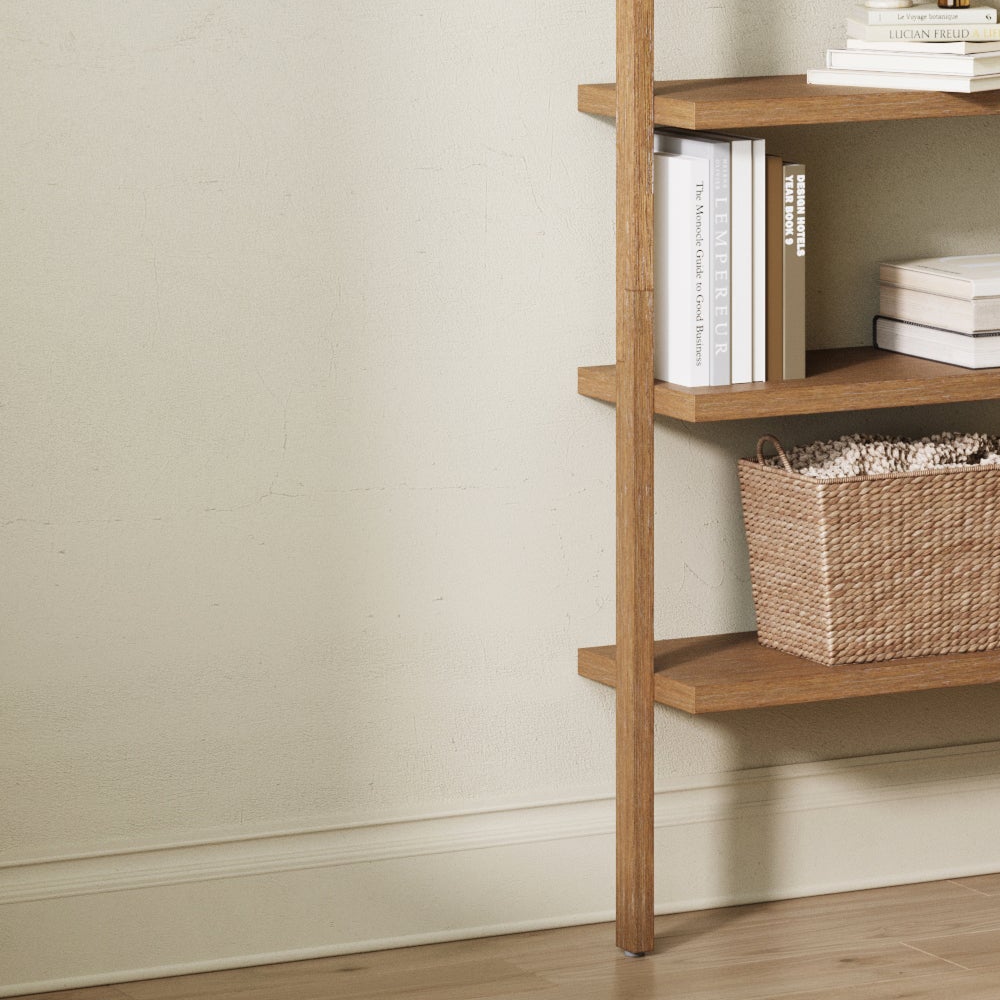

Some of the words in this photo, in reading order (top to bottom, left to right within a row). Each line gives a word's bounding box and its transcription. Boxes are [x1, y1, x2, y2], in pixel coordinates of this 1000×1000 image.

[906, 13, 927, 22] Voyage
[889, 29, 930, 39] LUCIAN
[934, 28, 970, 39] FREUD
[695, 181, 704, 201] The
[785, 175, 794, 208] YEAR
[797, 174, 806, 208] DESIGN
[695, 204, 704, 247] Monocle
[785, 210, 794, 236] BOOK
[797, 210, 806, 257] HOTELS
[785, 237, 794, 246] 9
[695, 249, 704, 279] Guide
[715, 196, 728, 355] LEMPEREUR
[695, 282, 703, 292] to
[695, 294, 704, 322] Good
[695, 325, 704, 367] Business
